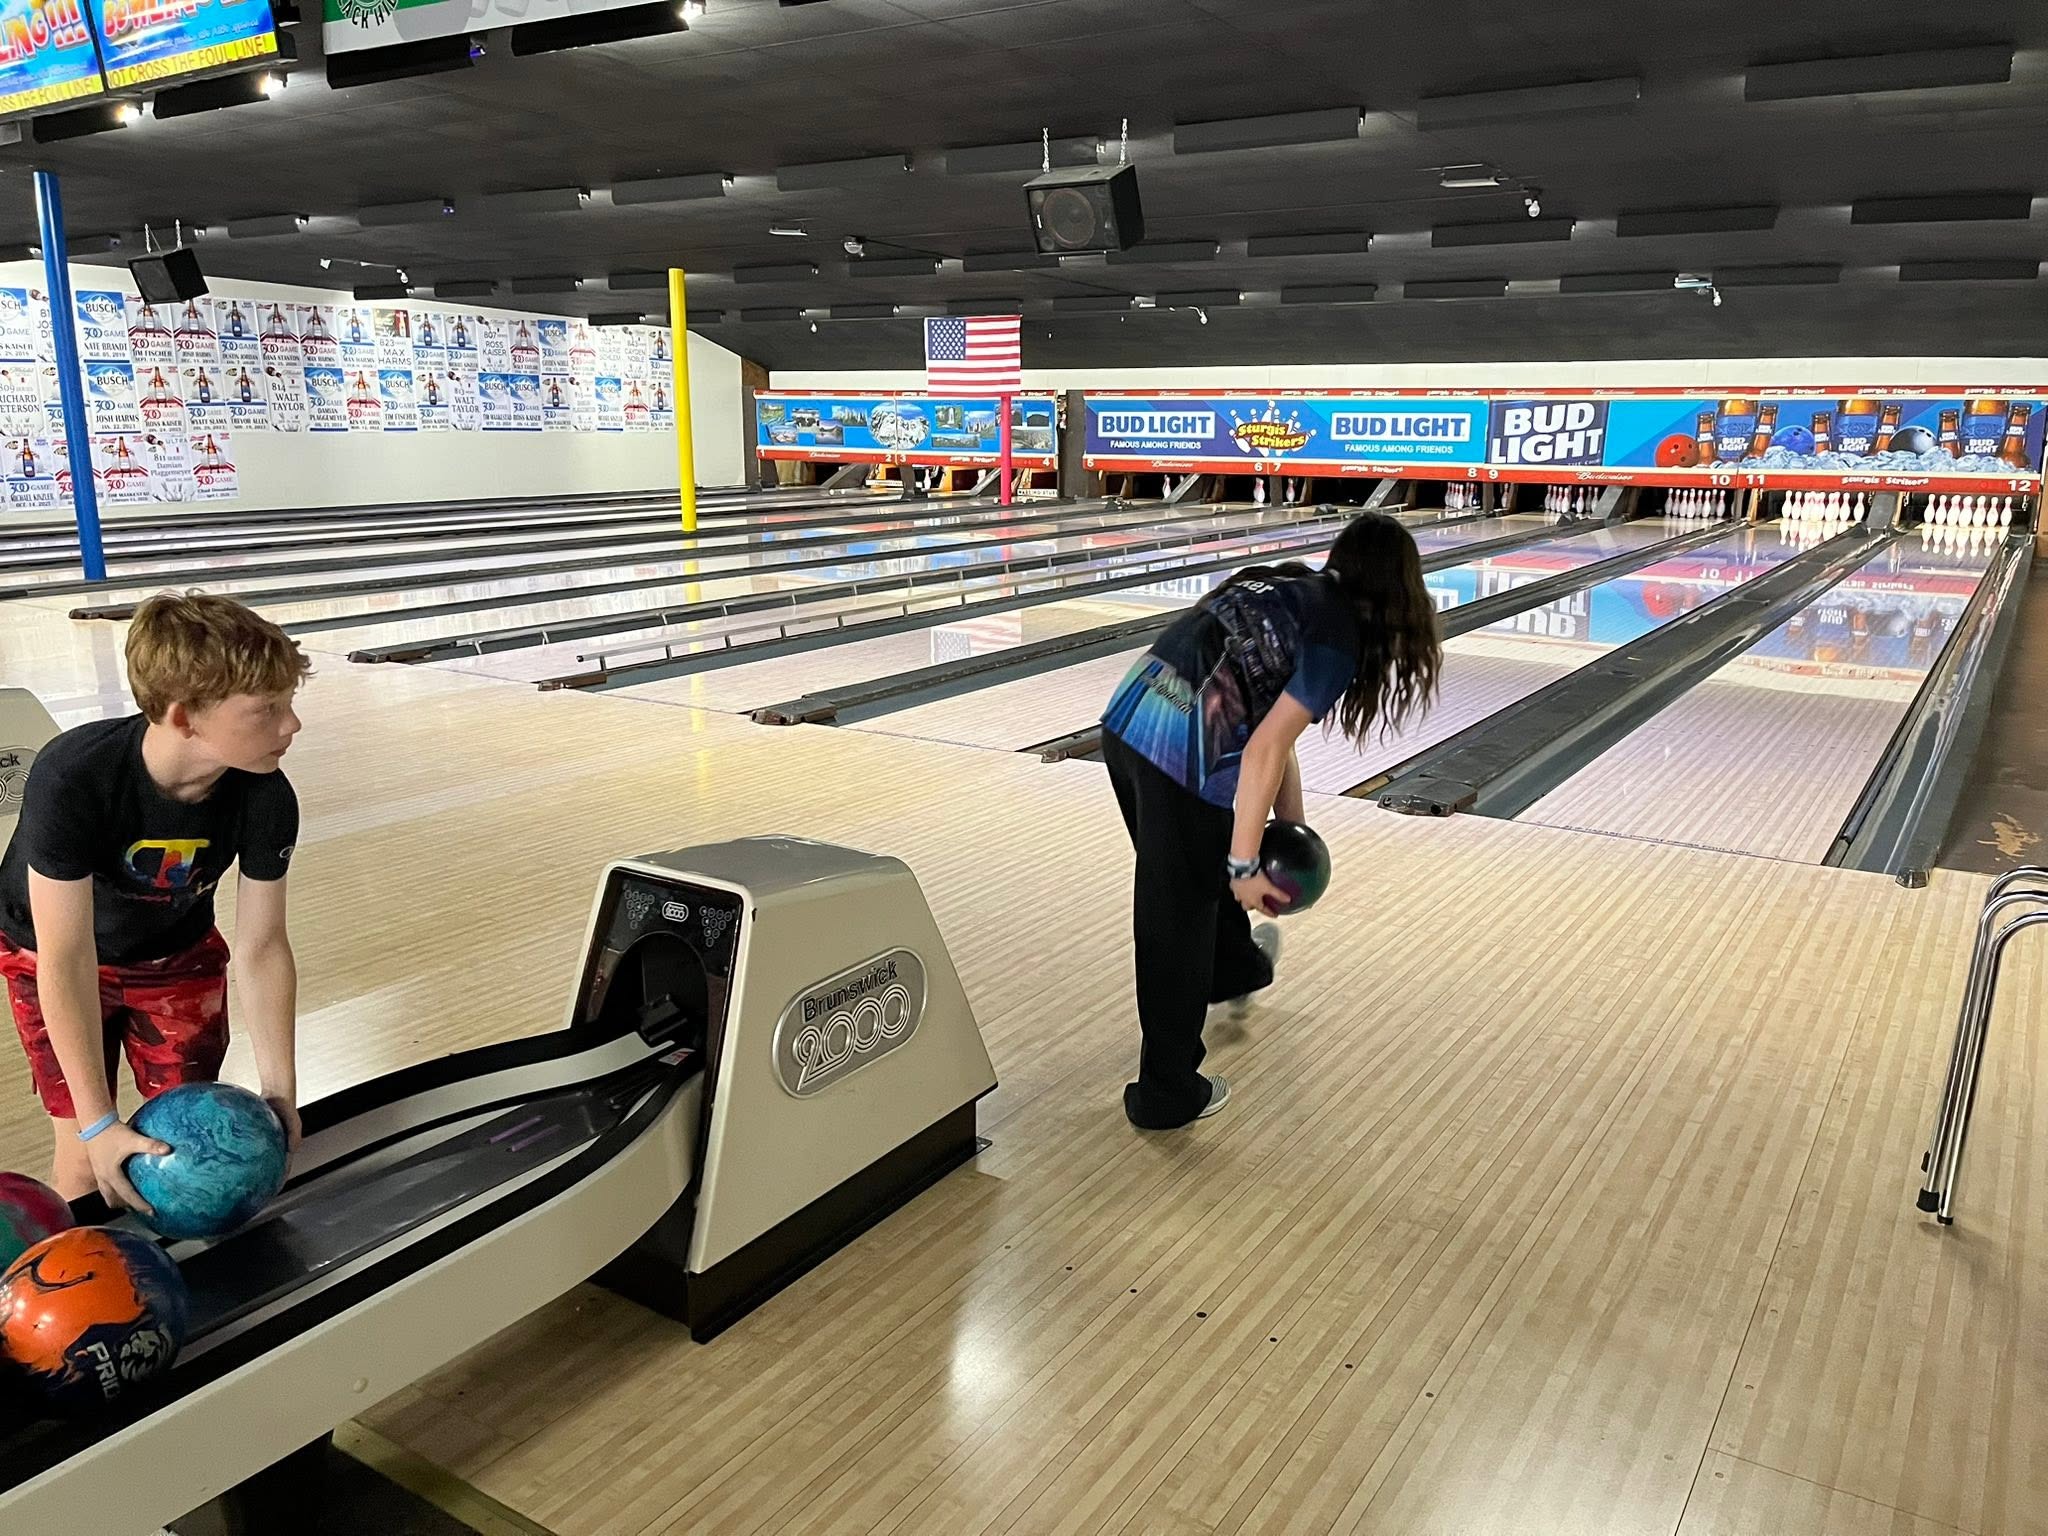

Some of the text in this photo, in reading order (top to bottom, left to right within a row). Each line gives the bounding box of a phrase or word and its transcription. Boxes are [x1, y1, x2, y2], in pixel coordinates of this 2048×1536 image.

[129, 60, 169, 83] CROSS
[173, 54, 195, 72] THE
[199, 44, 233, 66] FOUL
[85, 303, 117, 313] BUSCH
[6, 327, 31, 336] GAME
[83, 327, 126, 340] 300 GAME
[544, 329, 562, 337] BUSCH
[130, 338, 171, 351] 300 GAME
[175, 339, 215, 352] 300 GAME
[221, 340, 238, 352] 300
[262, 343, 299, 356] 300 GAME
[302, 345, 318, 356] 300
[341, 345, 357, 357] 300
[378, 358, 412, 366] HARMS
[97, 376, 128, 386] BUSCH
[311, 379, 339, 387] BUSCH
[385, 380, 409, 388] BUSCH
[484, 383, 507, 391] BUSCH
[514, 384, 537, 392] BUSCH
[275, 393, 299, 401] WALT
[454, 396, 475, 404] WALT
[95, 400, 115, 413] 300
[272, 402, 305, 411] TAYLOR
[452, 405, 480, 413] TAYLOR
[142, 409, 161, 420] 300
[188, 407, 206, 419] 300
[229, 406, 266, 418] 300 GAME
[96, 414, 140, 423] JOSH HARMS
[1503, 402, 1595, 436] BUD
[1102, 415, 1211, 434] BUD LIGHT
[1335, 417, 1466, 437] BUD LIGHT
[1238, 424, 1286, 436] Sturgis
[1110, 440, 1201, 450] FAMOUS AMONG FRIENDS
[1251, 434, 1305, 447] Strikers
[1842, 437, 1867, 445] BUD
[1969, 438, 1995, 446] BUD
[1344, 444, 1454, 454] FAMOUS AMONG FRIENDS
[1490, 428, 1603, 464] LIGHT
[1718, 442, 1749, 451] LIGHT
[1838, 443, 1871, 452] LIGHT
[1964, 444, 1999, 453] LIGHT
[885, 454, 892, 462] 2
[900, 454, 907, 462] 3
[1042, 457, 1051, 467] 4
[1254, 462, 1262, 471] 6
[1273, 462, 1281, 471] 7
[1467, 468, 1477, 478] 8
[1488, 469, 1499, 480] 9
[196, 475, 214, 487] 300
[1710, 475, 1731, 486] 10
[1745, 474, 1765, 485] 11
[9, 482, 29, 497] 300
[107, 479, 125, 491] 300
[2007, 480, 2032, 491] 12
[803, 958, 899, 1023] Brunswick
[791, 983, 912, 1092] 2000
